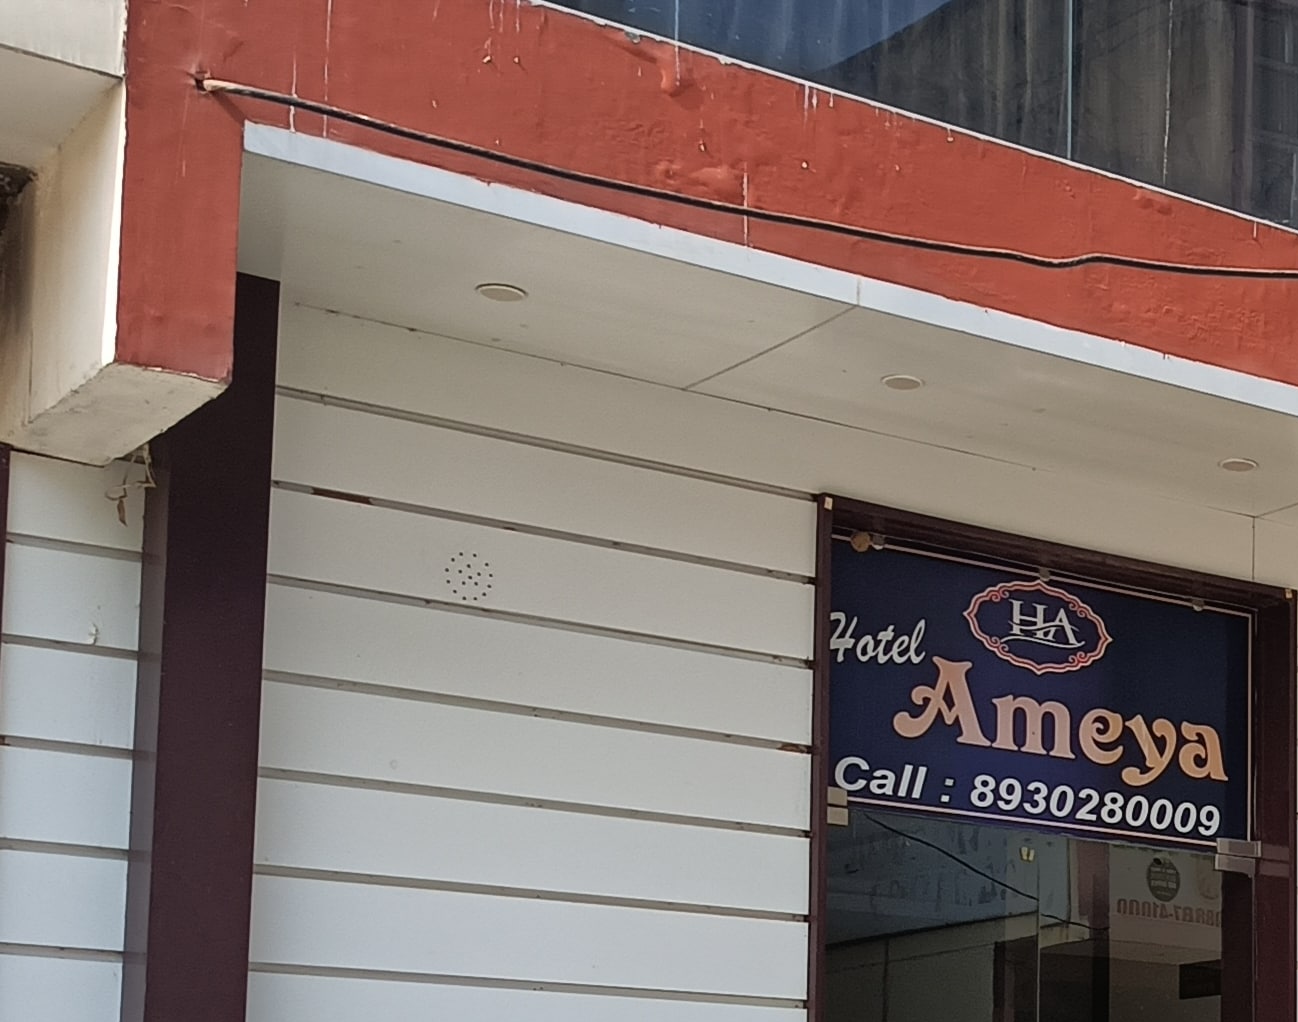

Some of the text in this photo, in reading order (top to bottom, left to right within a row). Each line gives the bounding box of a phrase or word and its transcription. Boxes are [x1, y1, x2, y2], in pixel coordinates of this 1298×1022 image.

[830, 611, 926, 664] Hotel
[893, 656, 1229, 787] Ameya
[834, 756, 929, 800] Call
[970, 774, 1221, 837] 8930280009
